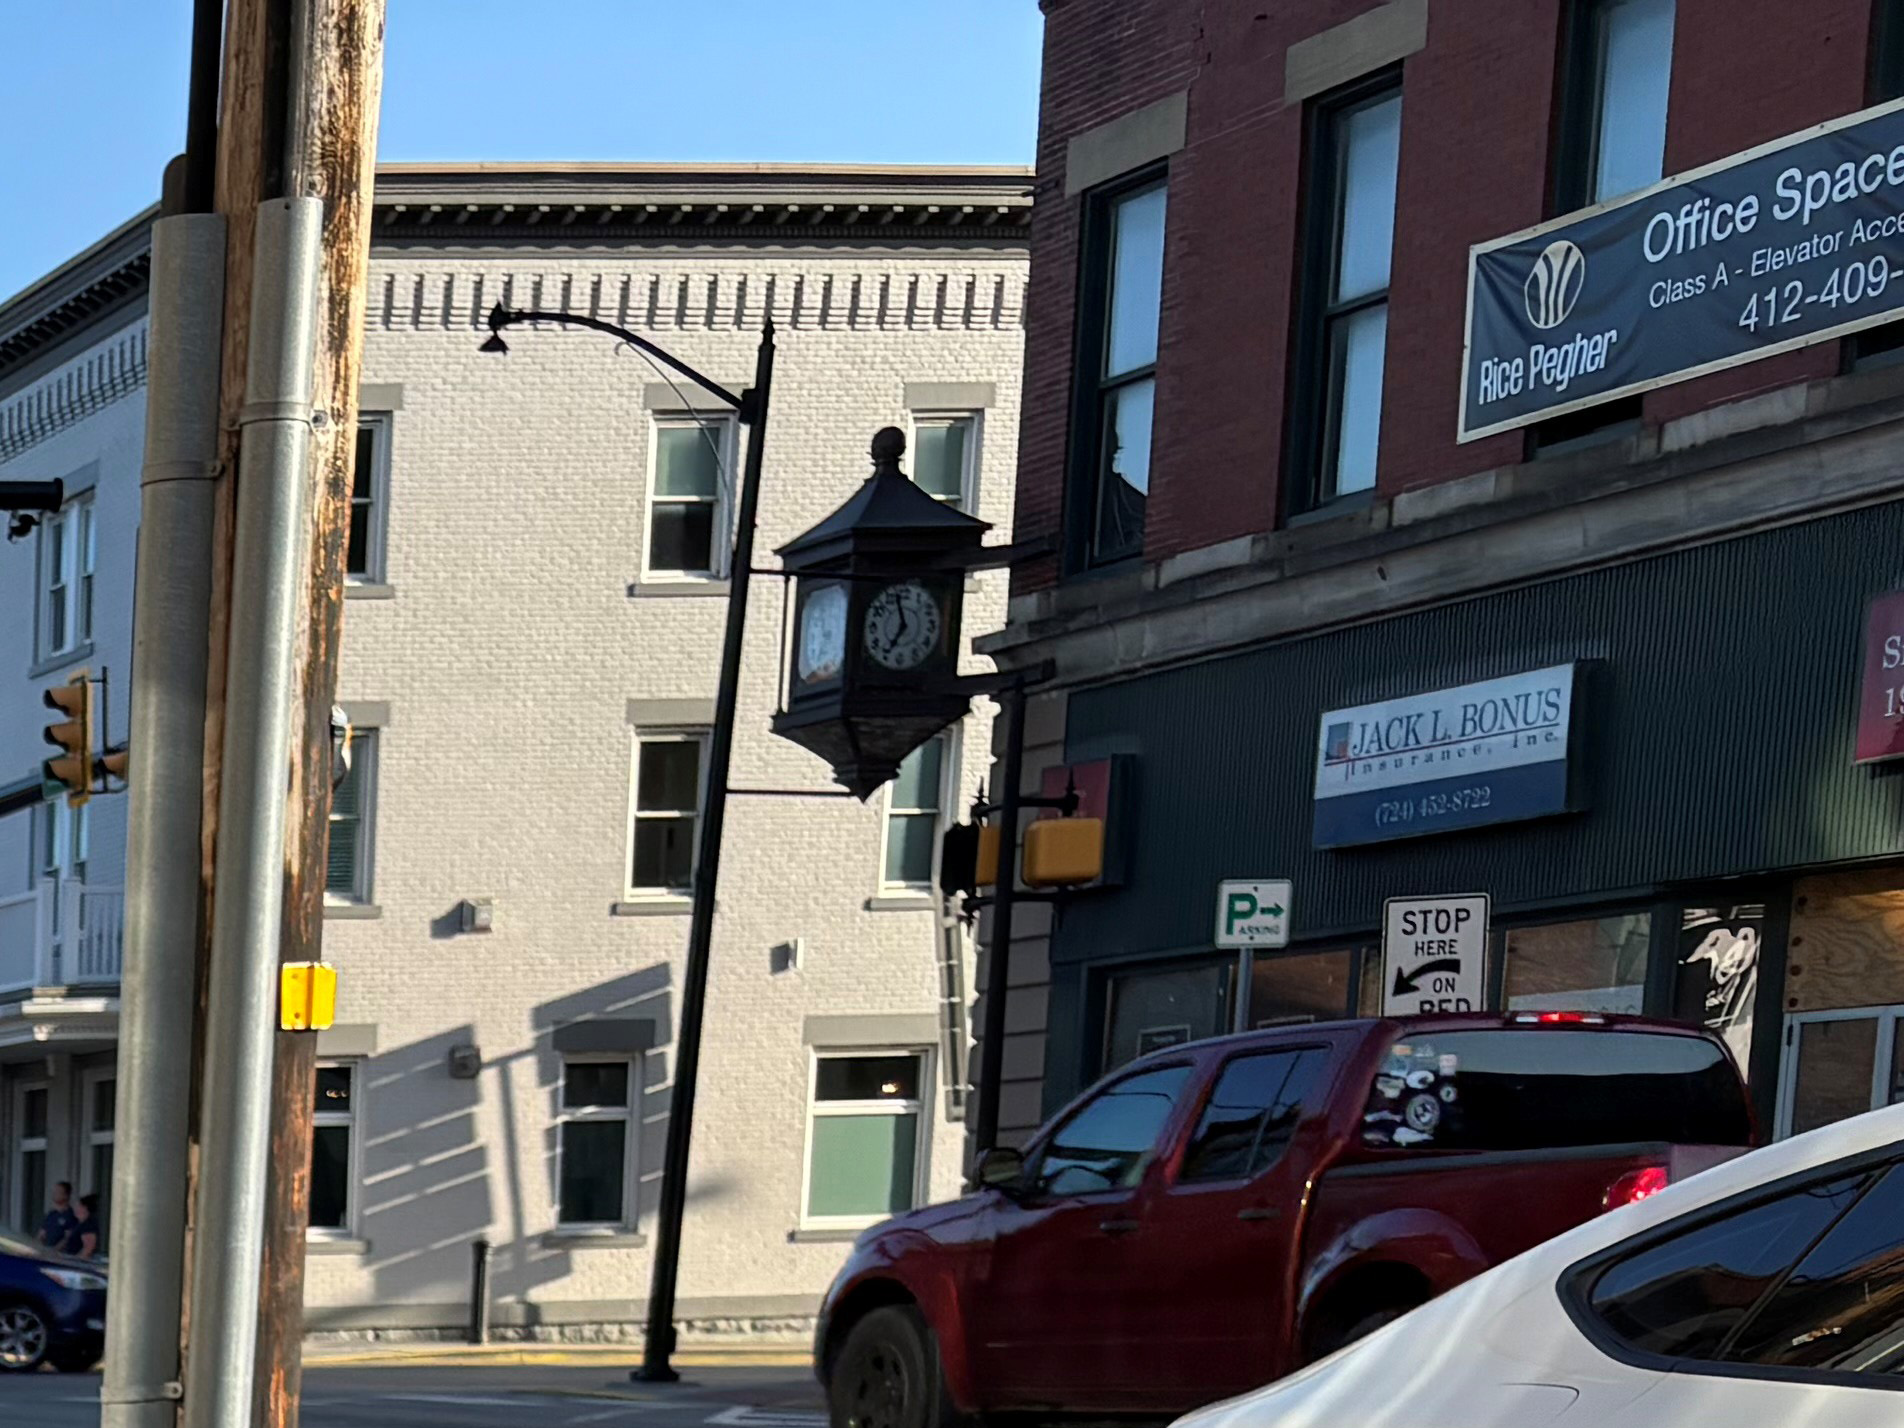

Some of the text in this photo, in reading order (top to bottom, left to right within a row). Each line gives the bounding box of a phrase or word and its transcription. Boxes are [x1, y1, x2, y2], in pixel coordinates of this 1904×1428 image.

[1643, 144, 1904, 263] Office Space
[1649, 274, 1707, 309] Class
[1711, 262, 1729, 290] A
[1750, 230, 1844, 278] Elevator
[1479, 329, 1618, 405] Rice Pegher
[1352, 687, 1561, 757] JACK L. BONUS
[1401, 908, 1471, 936] STOP
[1414, 939, 1458, 956] HERE
[1432, 977, 1456, 993] ON
